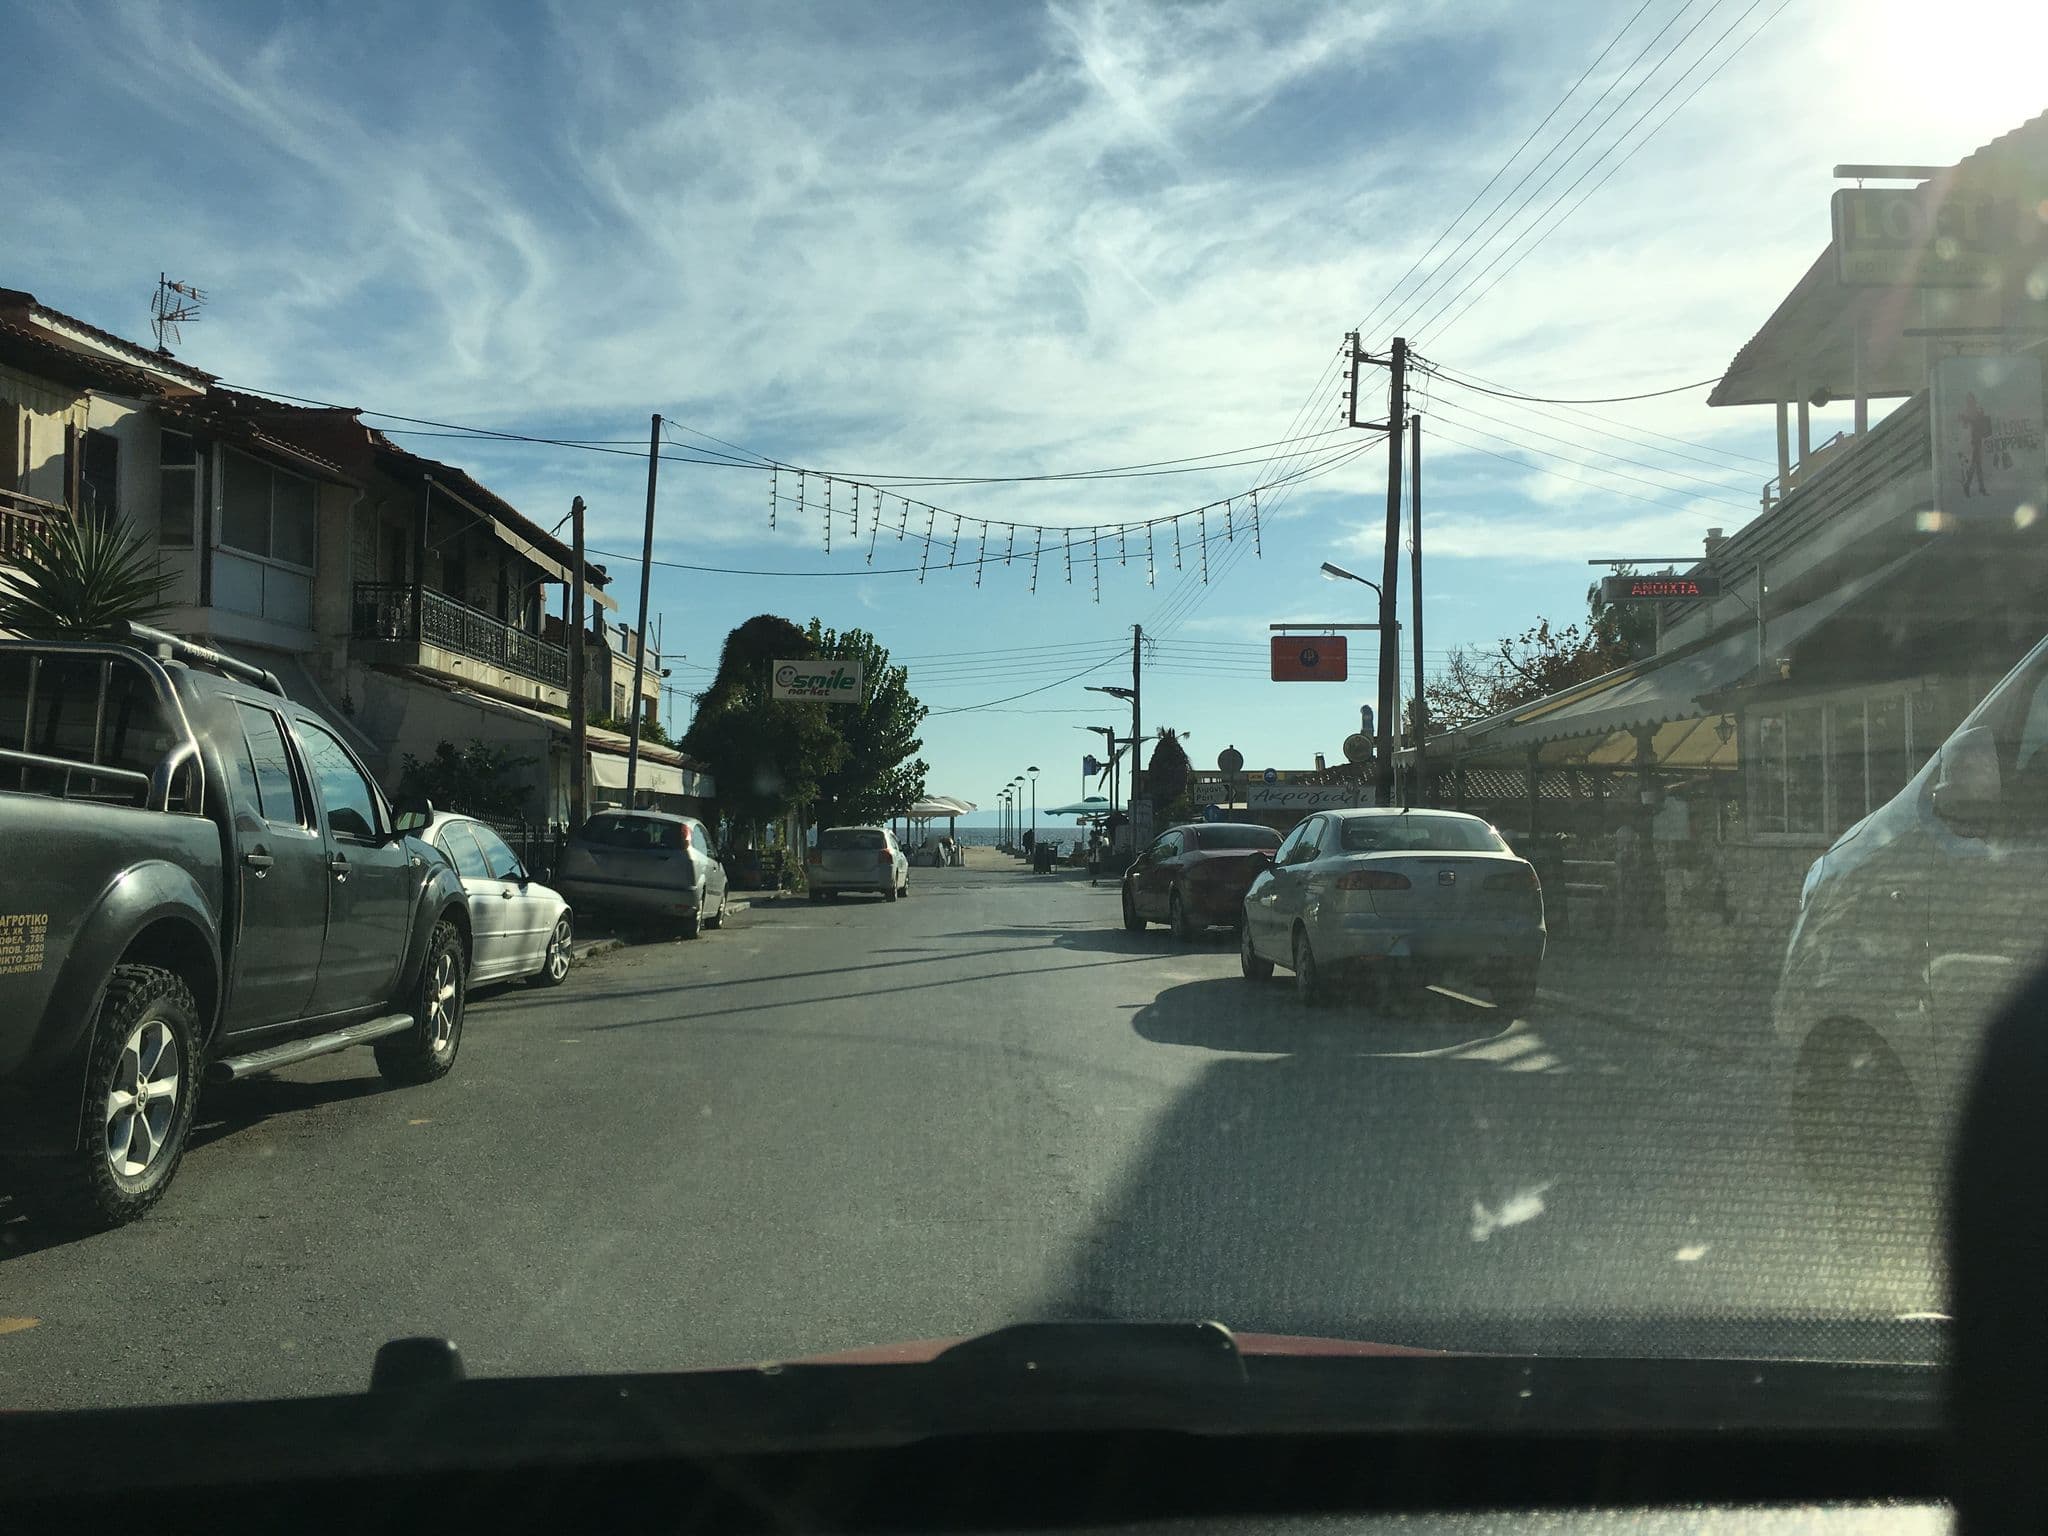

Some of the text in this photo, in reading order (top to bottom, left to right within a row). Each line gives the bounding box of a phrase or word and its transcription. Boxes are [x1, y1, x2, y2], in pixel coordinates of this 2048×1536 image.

[792, 667, 856, 689] smile
[1253, 788, 1369, 806] Ακρογιάι
[0, 914, 48, 926] ΑΓΡΟΤΙΚΟ
[25, 944, 44, 953] 2020
[0, 955, 22, 965] ΙΚΤΟ
